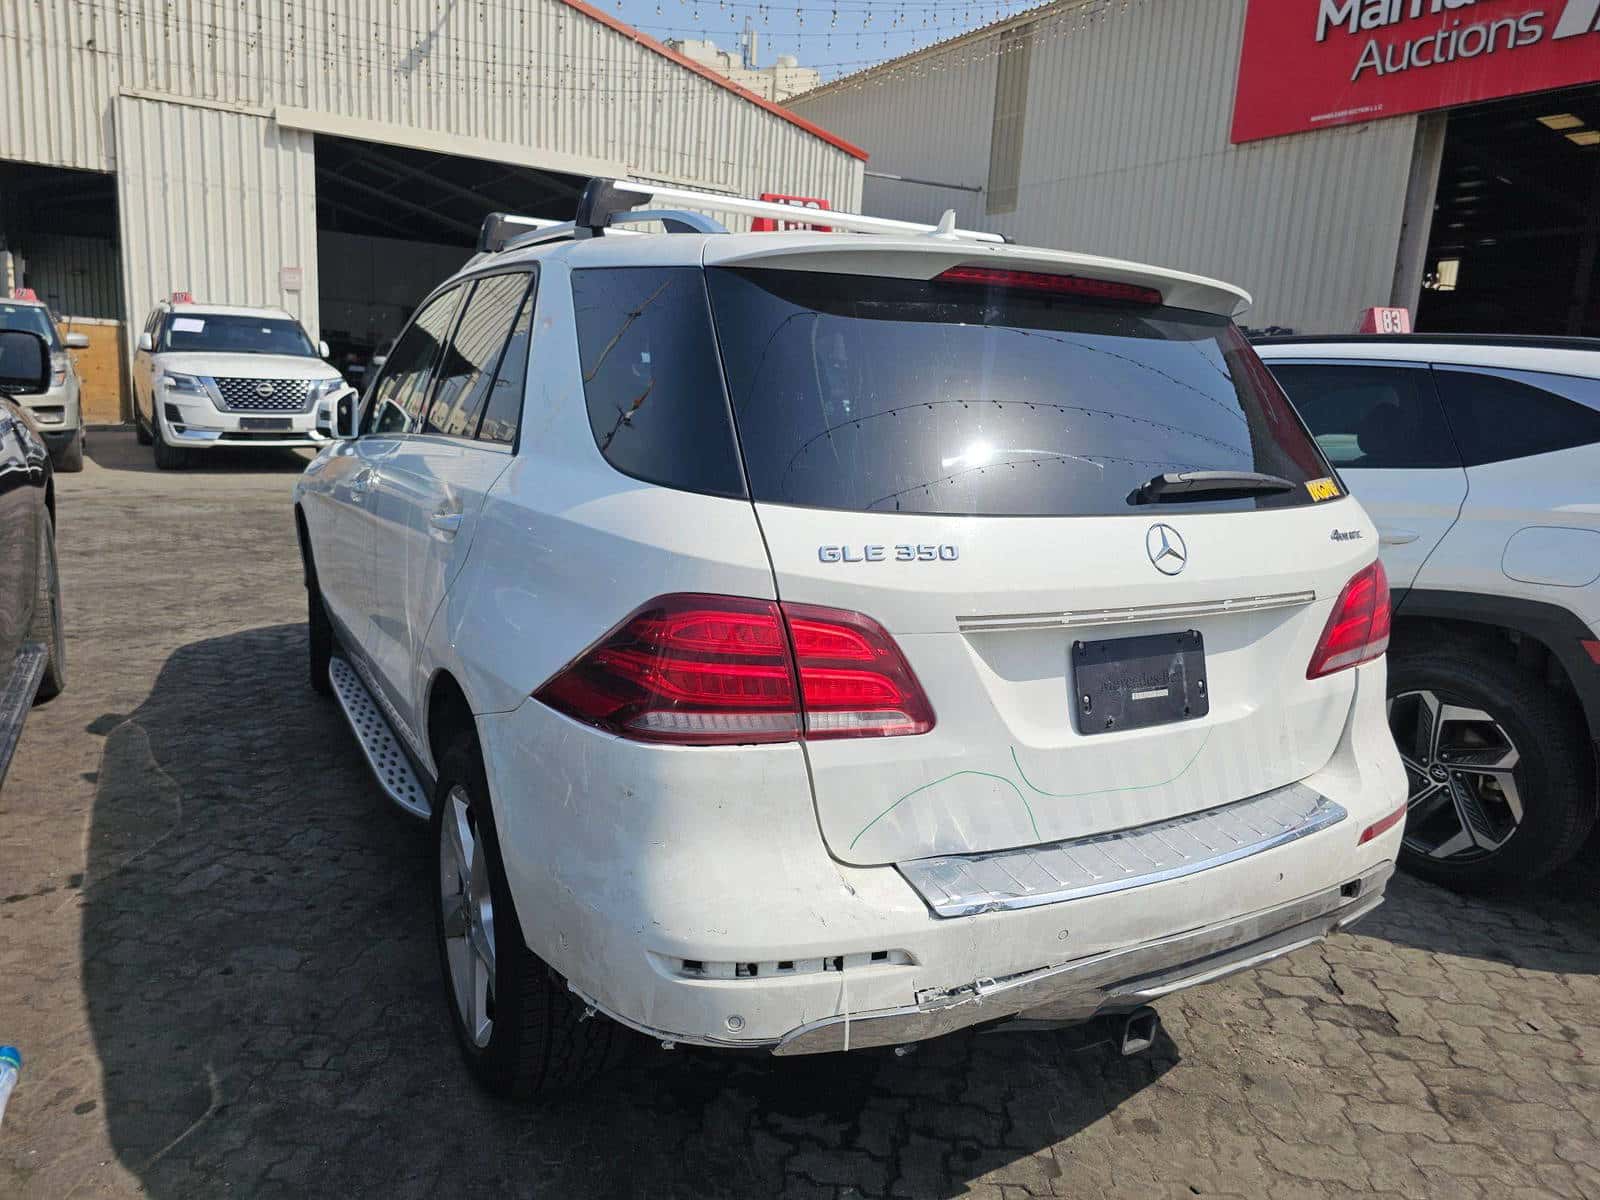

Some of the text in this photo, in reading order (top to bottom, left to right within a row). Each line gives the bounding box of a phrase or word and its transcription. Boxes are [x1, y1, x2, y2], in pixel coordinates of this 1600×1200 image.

[1351, 11, 1544, 81] Auctions
[1382, 310, 1402, 332] 83
[818, 543, 960, 563] GLE 350
